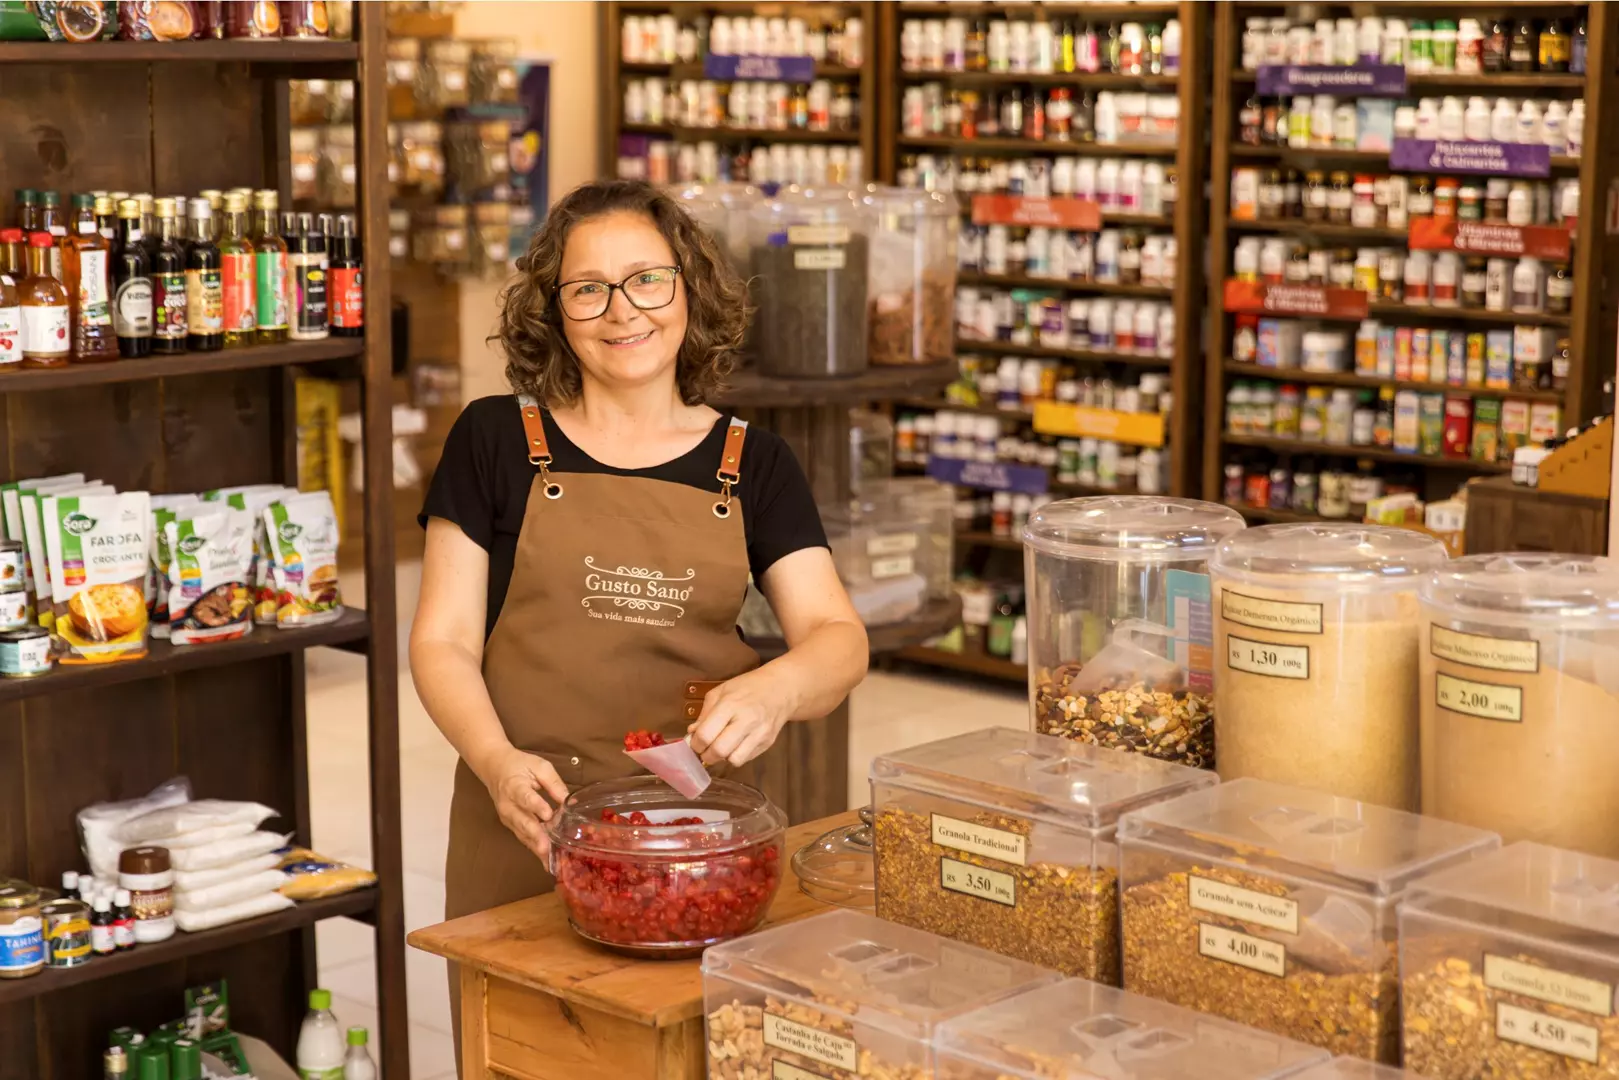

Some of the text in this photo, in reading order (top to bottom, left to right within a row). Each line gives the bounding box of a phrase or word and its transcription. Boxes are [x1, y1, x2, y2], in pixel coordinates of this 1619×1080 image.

[585, 573, 641, 595] Gusto
[588, 609, 602, 619] Sua
[604, 611, 622, 621] vida
[624, 615, 644, 624] mais
[1250, 649, 1277, 666] 1,30
[1460, 690, 1489, 709] 2,00
[938, 826, 1018, 853] Granola Tradicional
[966, 873, 991, 892] 3,50
[1197, 888, 1234, 905] Granola
[1236, 899, 1254, 909] sem
[1228, 938, 1257, 958] 4,00
[775, 1020, 811, 1041] Castanha
[812, 1033, 822, 1043] de
[823, 1037, 843, 1051] Caju
[1530, 1020, 1566, 1042] 4,50
[776, 1031, 806, 1050] Torrada
[813, 1044, 845, 1062] Salgada
